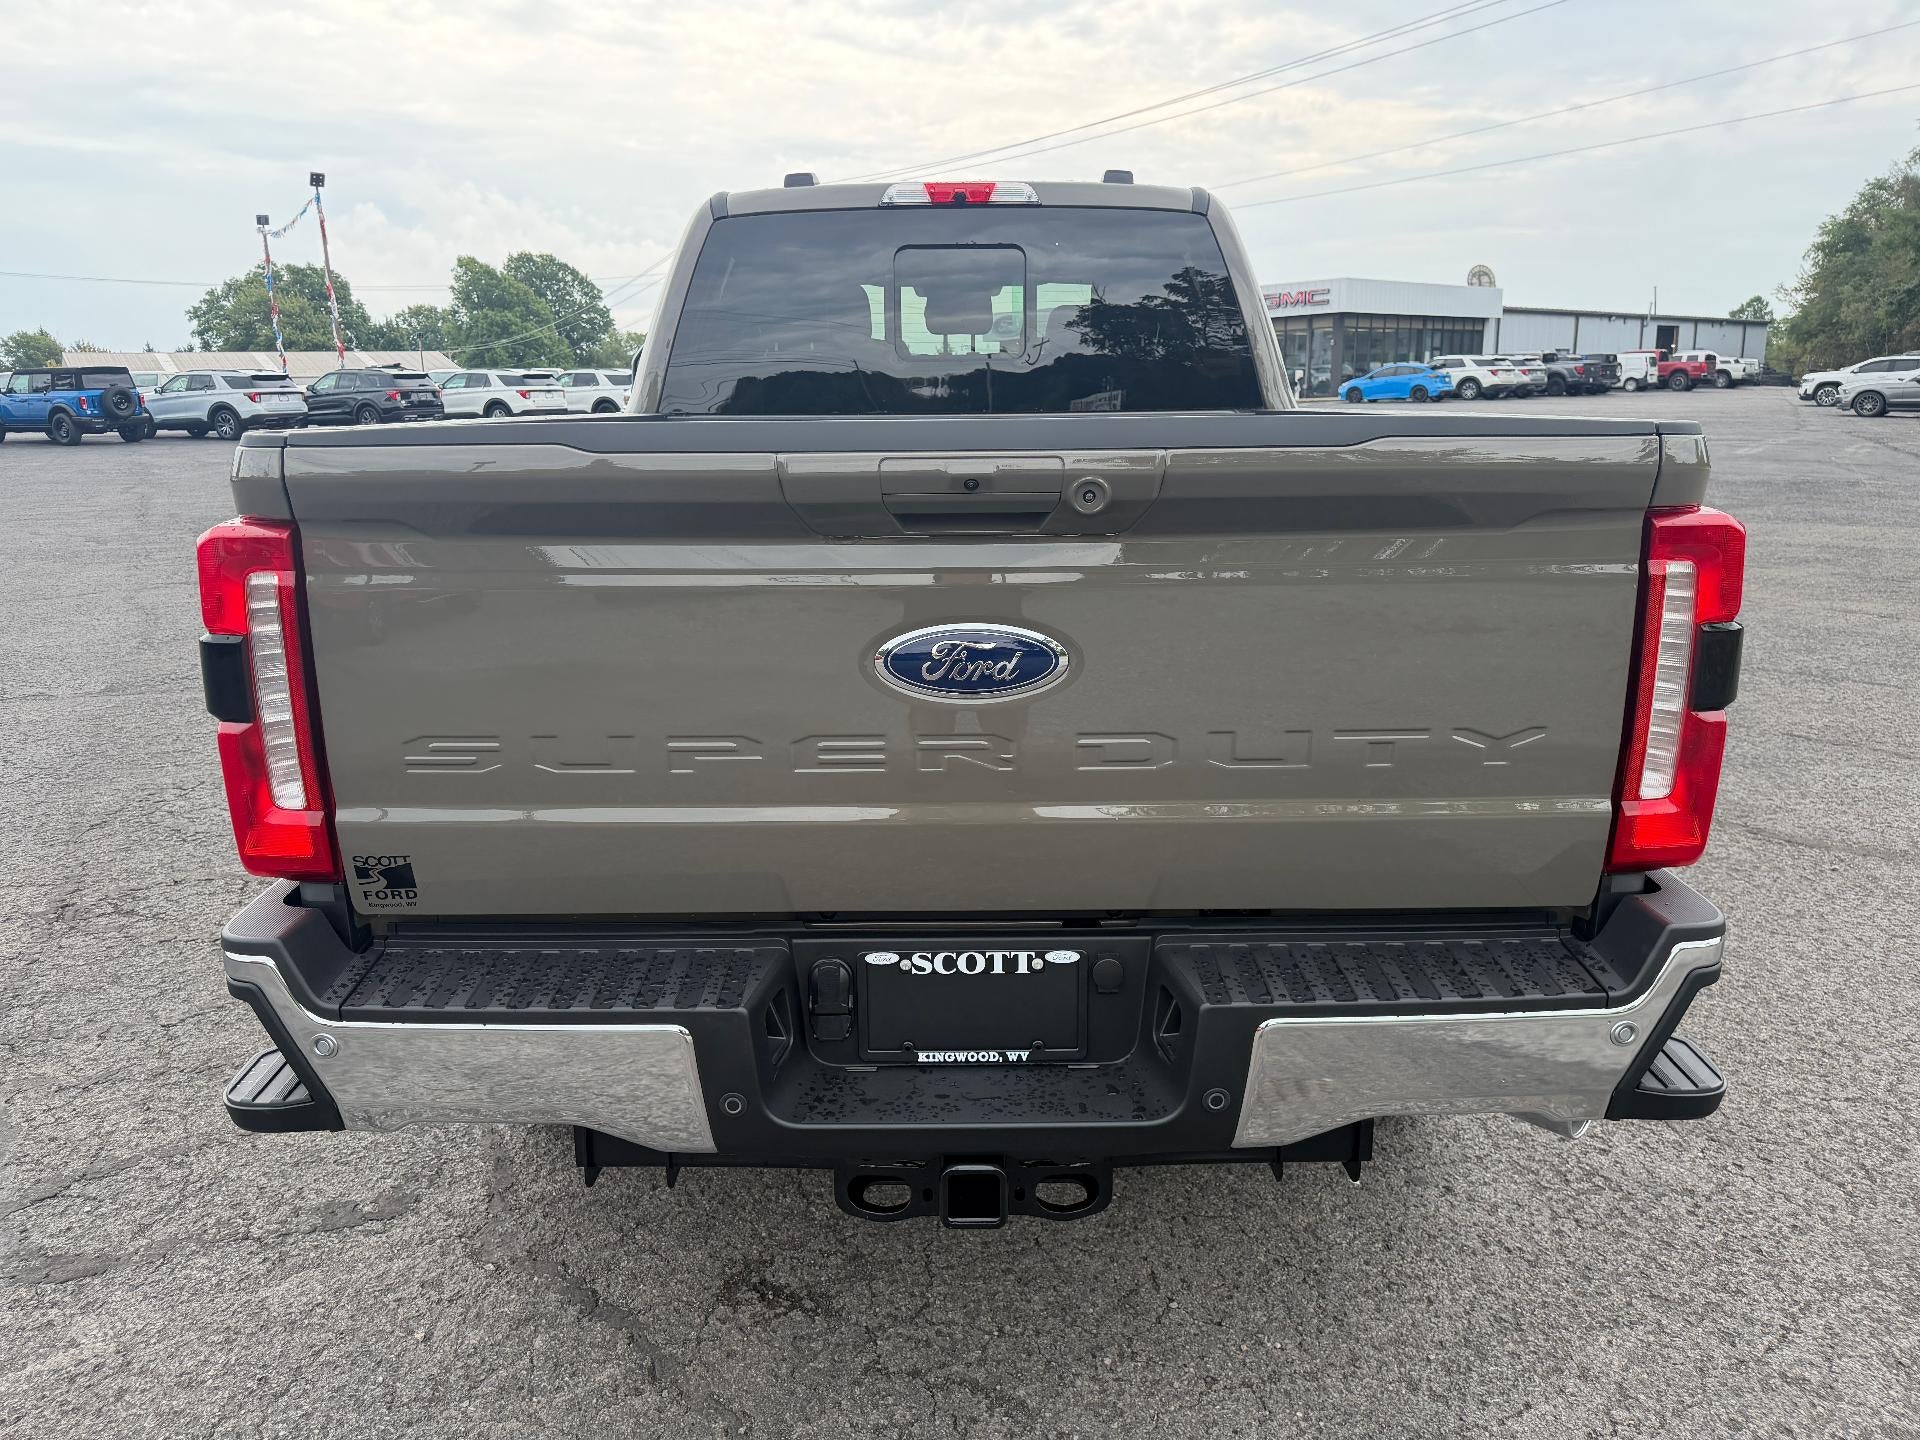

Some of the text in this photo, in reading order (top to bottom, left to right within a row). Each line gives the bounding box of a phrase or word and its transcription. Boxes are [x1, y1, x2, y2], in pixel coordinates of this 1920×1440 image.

[921, 640, 1024, 681] Ford
[403, 726, 1548, 774] SUPER DUTY
[352, 855, 411, 867] SCOTT
[363, 889, 418, 900] FORD
[911, 952, 1036, 975] SCOTT
[917, 1051, 1030, 1063] KINGWOOD, WV
